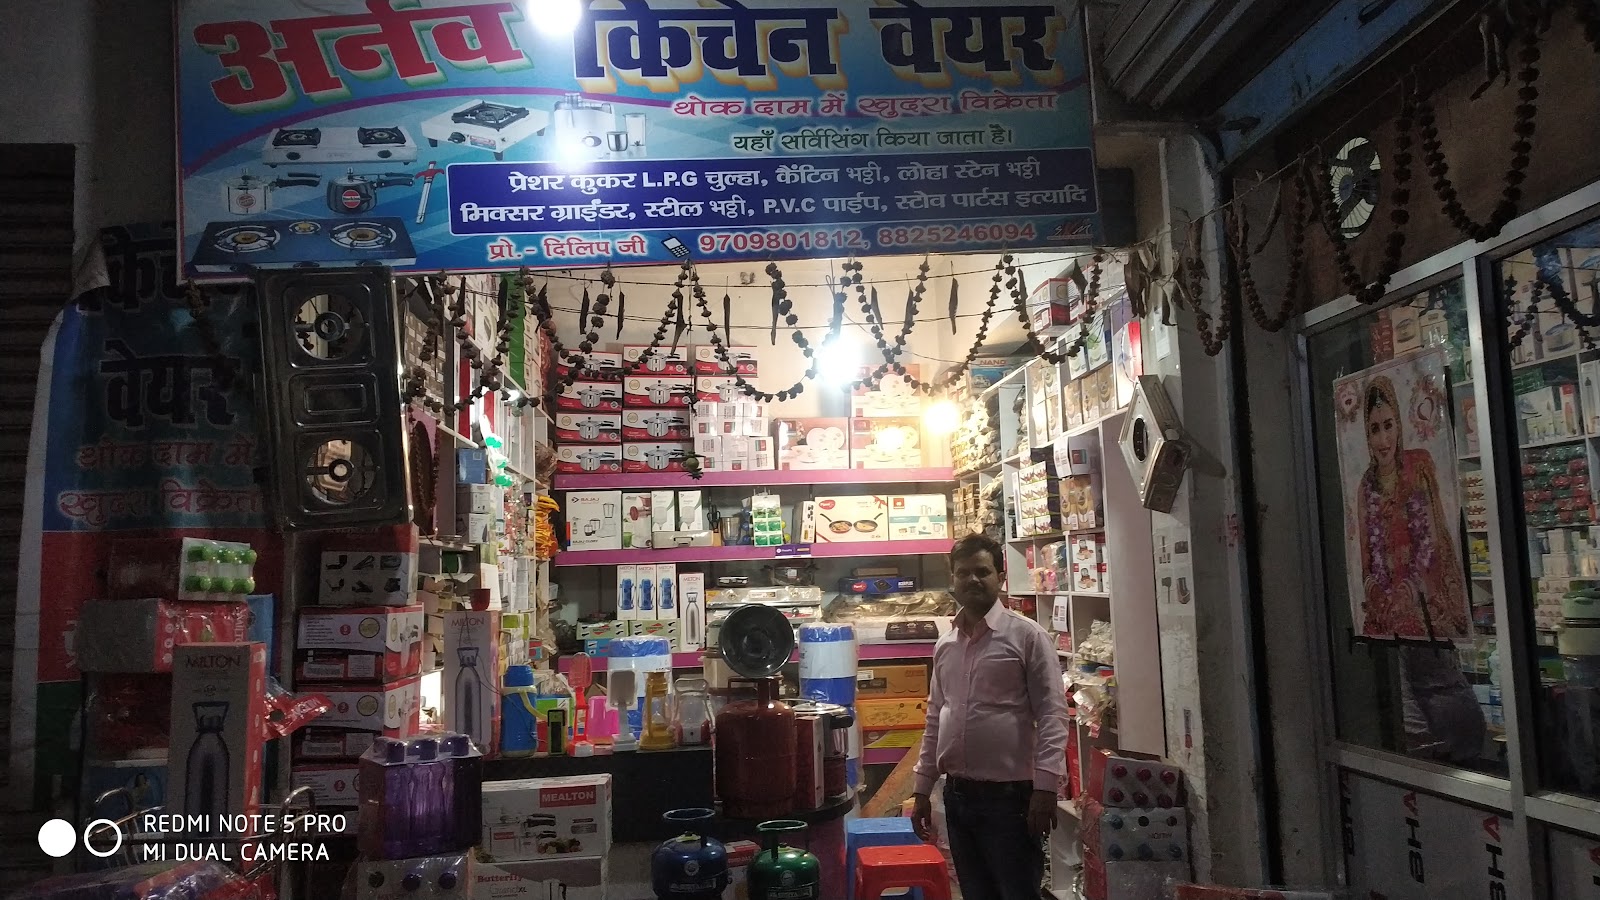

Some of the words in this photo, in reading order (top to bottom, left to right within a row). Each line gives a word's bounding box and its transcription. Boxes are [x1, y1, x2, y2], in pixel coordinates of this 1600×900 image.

[674, 95, 744, 116] थोक
[754, 100, 811, 116] दाम
[821, 93, 846, 115] में
[859, 97, 951, 118] खुदरा
[961, 90, 1057, 111] विक्रेता
[734, 129, 775, 151] यहाँ
[876, 127, 930, 146] किया
[936, 130, 985, 146] जाता
[508, 171, 566, 193] प्रेशर
[570, 173, 637, 195] कुकर
[642, 171, 698, 188] L.P.G
[775, 163, 840, 184] कैंटिन
[897, 161, 949, 181] लोहा
[954, 159, 1000, 178] स्टेन
[459, 202, 546, 222] मिक्सर
[643, 197, 704, 217] स्टील
[763, 198, 816, 214] P.V.C
[822, 191, 888, 214] पाईप,
[894, 190, 946, 210] स्टोव
[1014, 184, 1089, 208] इत्यादि
[543, 237, 611, 258] दिलिप
[617, 235, 646, 256] जी
[700, 229, 870, 252] 9709801812,
[878, 222, 1035, 245] 8825246094
[451, 617, 484, 627] MILTON
[185, 654, 241, 669] MILTON
[541, 790, 595, 803] MEALTON
[477, 873, 524, 883] Butterfly
